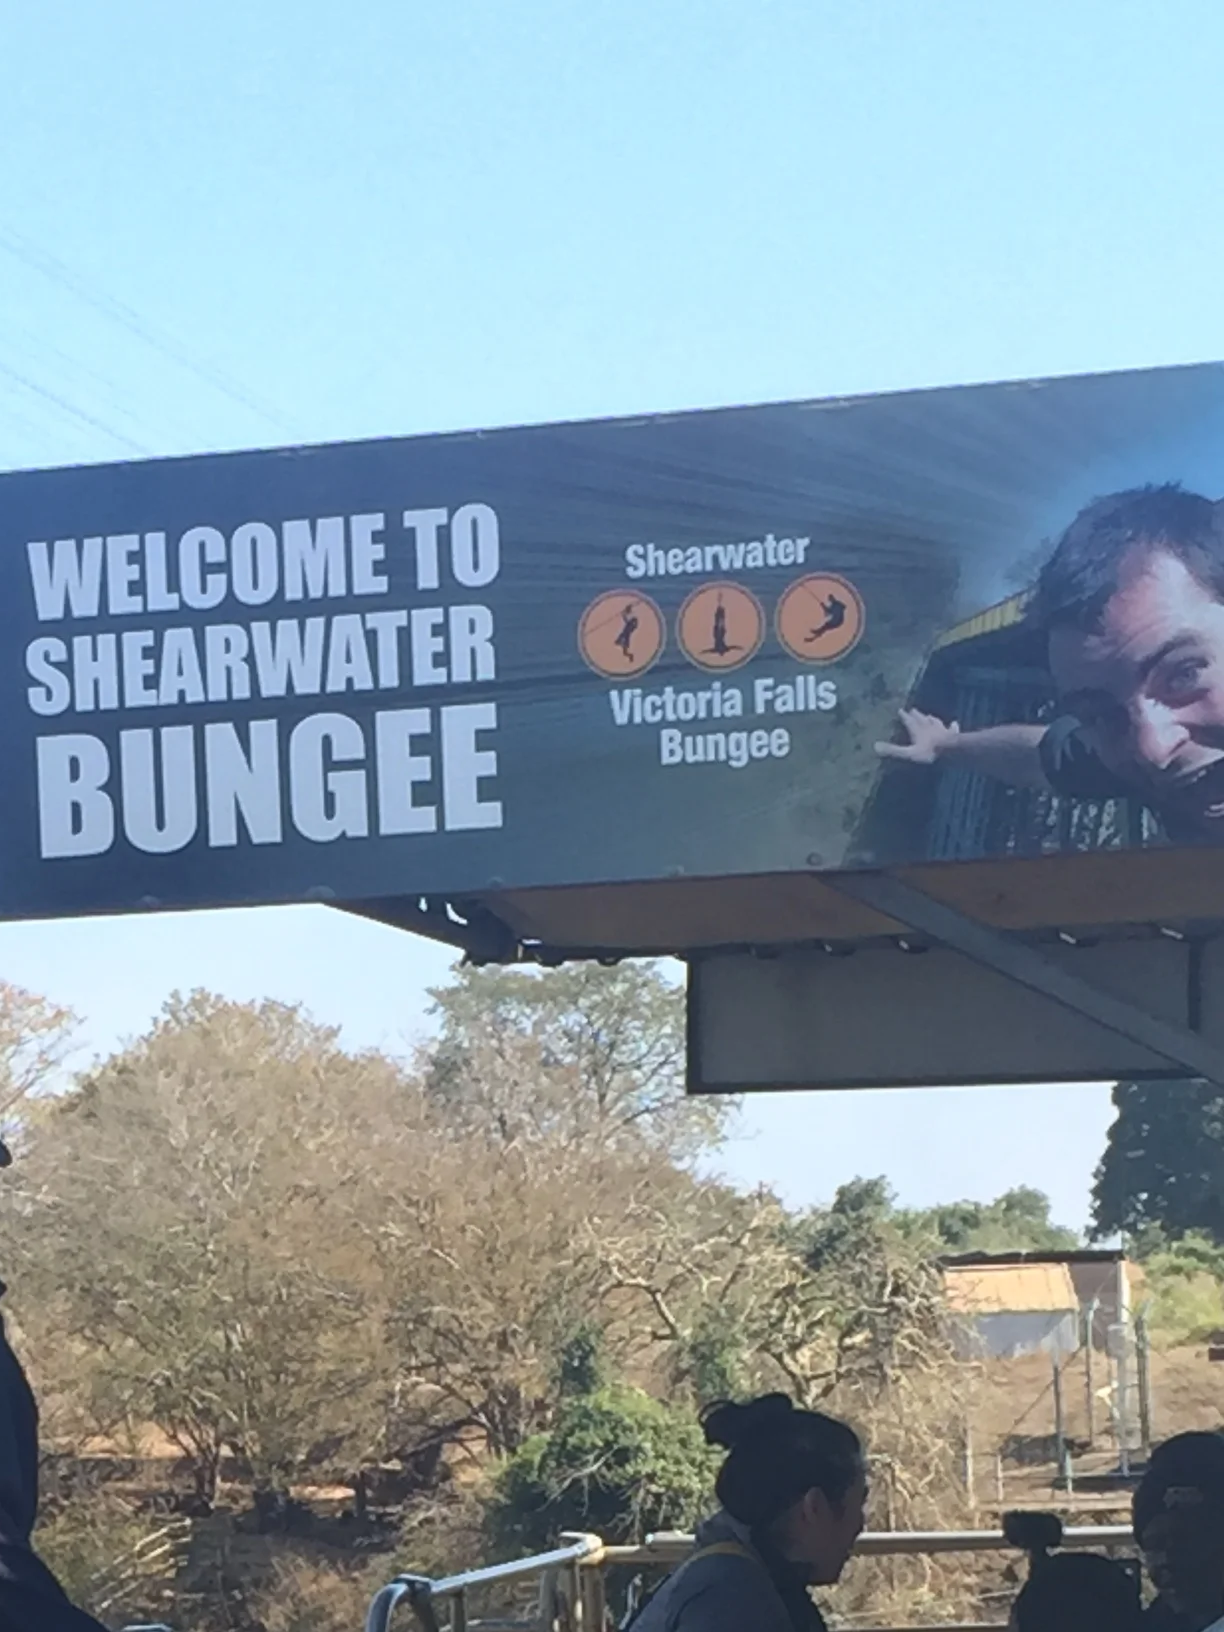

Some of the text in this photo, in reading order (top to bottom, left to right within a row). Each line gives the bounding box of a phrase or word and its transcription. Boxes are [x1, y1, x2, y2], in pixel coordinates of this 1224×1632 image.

[27, 502, 501, 622] WELCOME TO
[626, 534, 810, 579] Shearwater
[25, 604, 496, 716] SHEARWATER
[609, 675, 838, 726] Victoria Falls
[35, 702, 503, 860] BUNGEE
[660, 727, 791, 767] Bungee
